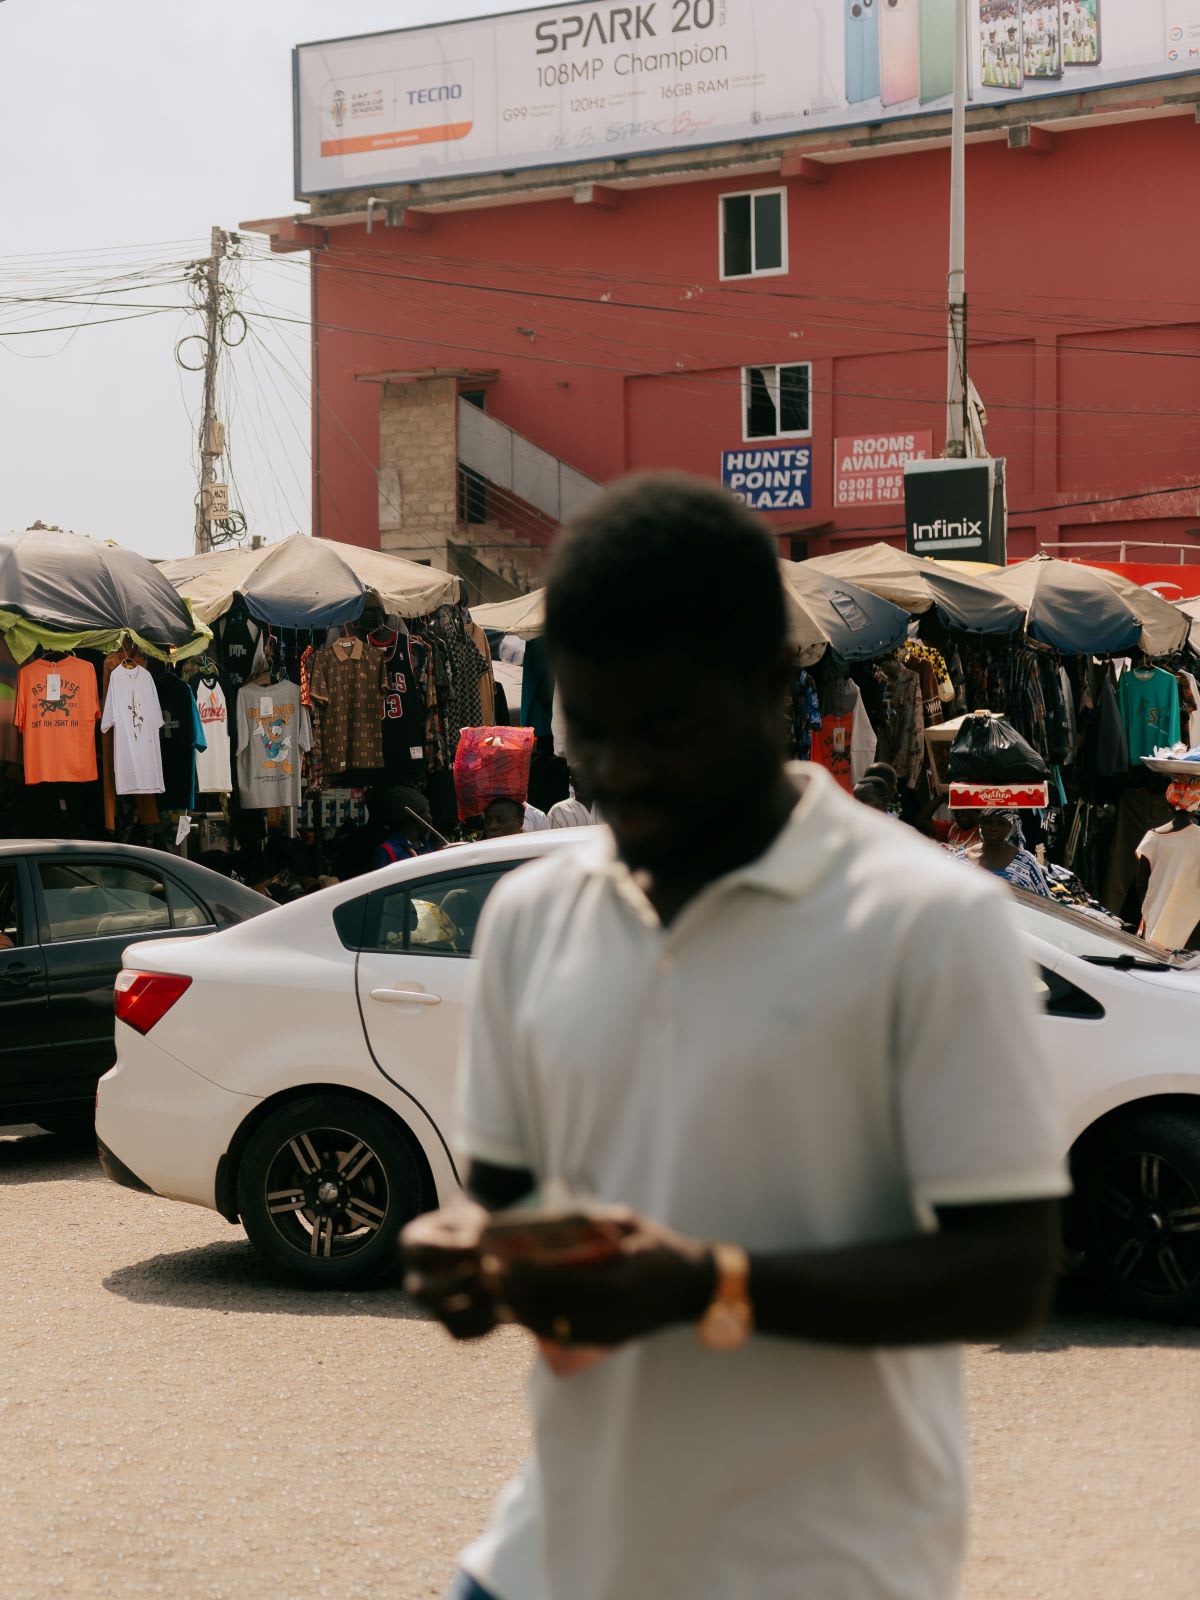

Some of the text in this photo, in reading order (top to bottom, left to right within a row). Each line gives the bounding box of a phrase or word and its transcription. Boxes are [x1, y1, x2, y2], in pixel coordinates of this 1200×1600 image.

[535, 3, 656, 54] SPARK
[671, 0, 714, 33] 20
[537, 44, 728, 88] 108MP Champion
[406, 84, 462, 105] TECNO
[660, 81, 692, 99] 16GB
[698, 78, 729, 97] RAM
[502, 106, 528, 121] G99
[853, 435, 915, 455] ROOMS
[727, 449, 810, 471] HUNTS
[730, 469, 807, 490] POINT
[912, 518, 982, 540] Infinix
